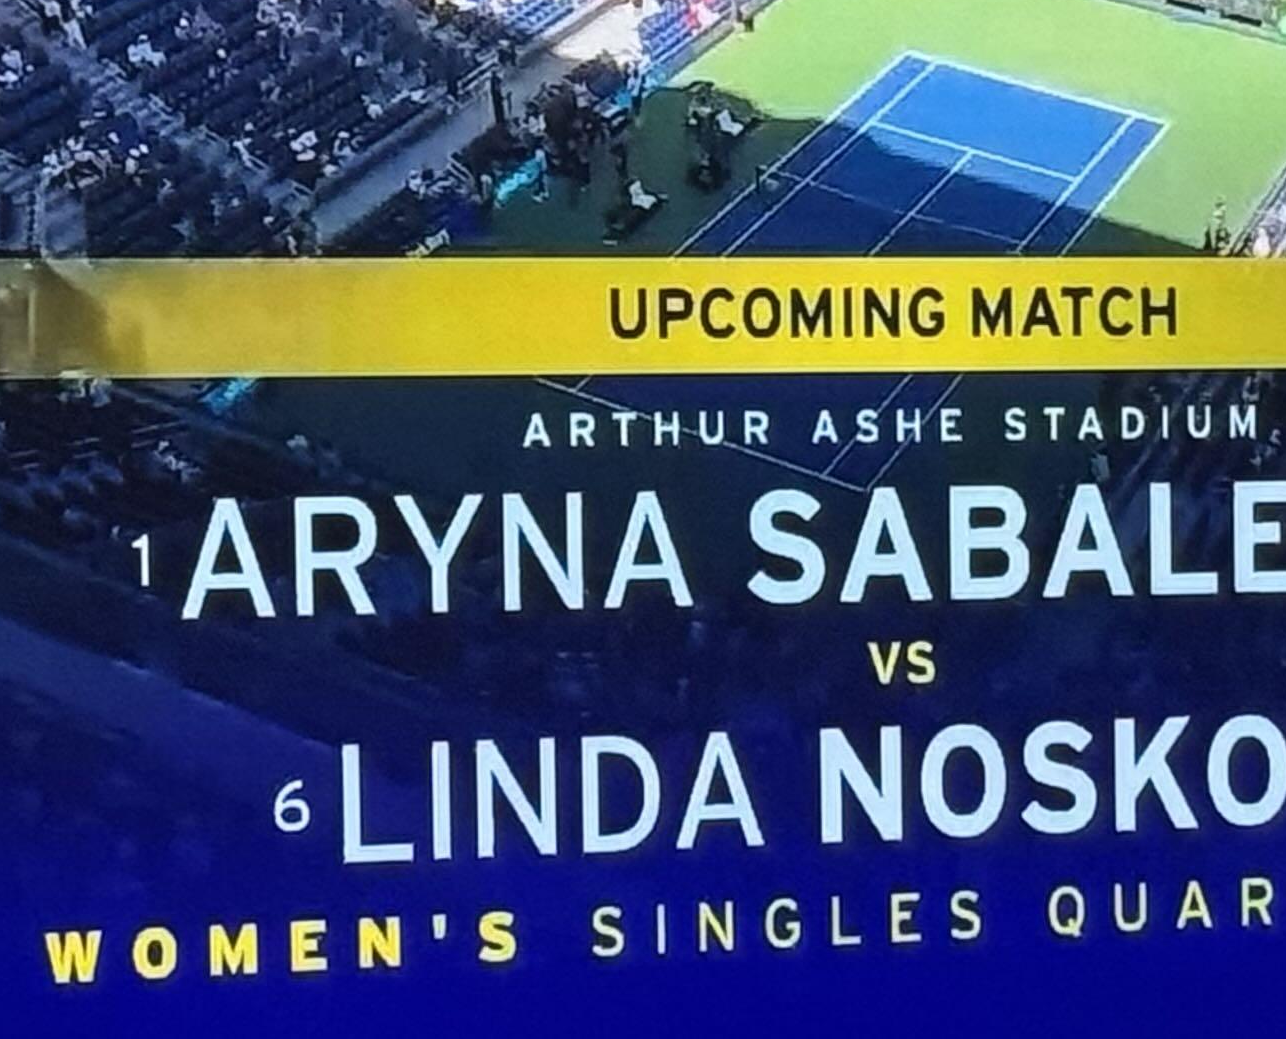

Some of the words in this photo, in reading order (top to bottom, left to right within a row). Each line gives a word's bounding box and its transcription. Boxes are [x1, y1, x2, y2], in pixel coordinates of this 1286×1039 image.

[609, 287, 944, 339] UPCOMING
[971, 286, 1177, 337] MATCH
[522, 410, 769, 448] ARTHUR
[811, 408, 964, 444] ASHE
[1004, 404, 1257, 441] STADIUM
[130, 533, 150, 587] 1
[181, 490, 694, 620] ARYNA
[867, 640, 936, 685] VS
[273, 779, 310, 832] 6
[341, 731, 765, 864] LINDA
[44, 911, 517, 984] WOMEN'S
[592, 890, 981, 957] SINGLES
